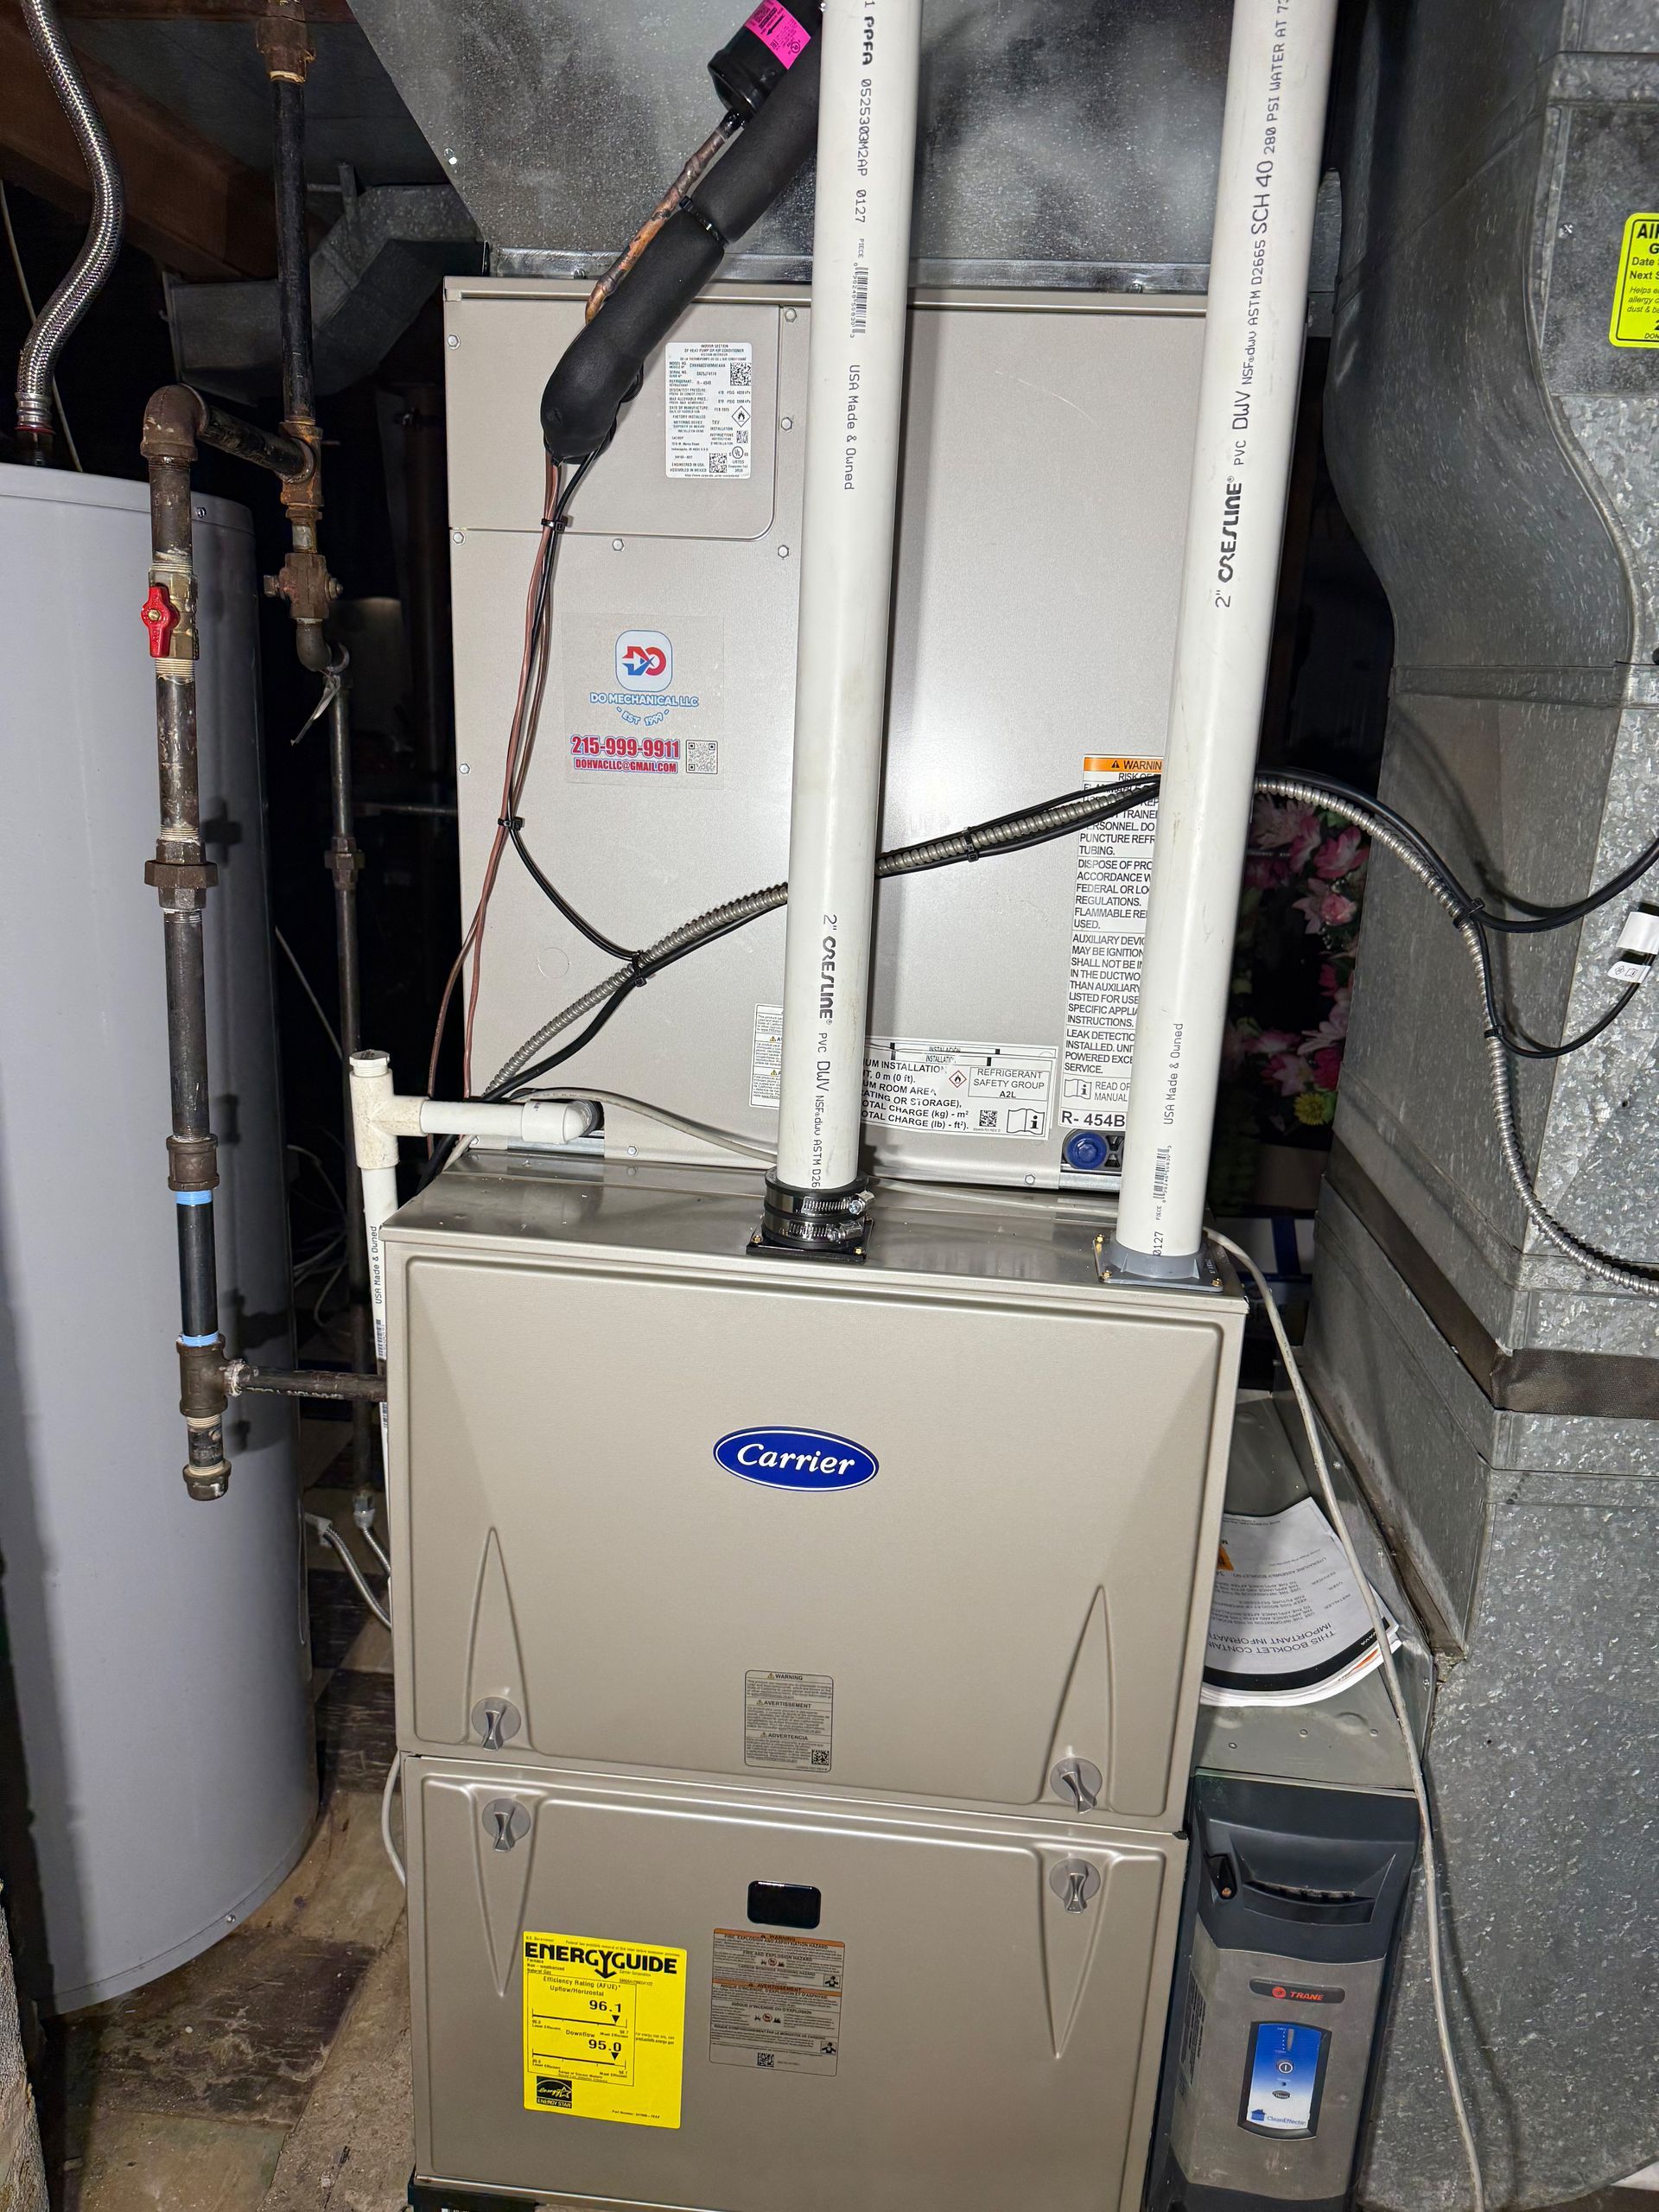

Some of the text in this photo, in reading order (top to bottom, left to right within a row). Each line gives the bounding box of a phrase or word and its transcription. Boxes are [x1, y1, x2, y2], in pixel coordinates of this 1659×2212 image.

[1275, 20, 1287, 37] AT
[1270, 43, 1285, 92] WATER
[1267, 97, 1280, 121] PSI
[855, 16, 875, 224] PPFA 0525303M2AP 0127
[1263, 127, 1276, 155] 280
[1255, 161, 1273, 188] 40
[1251, 194, 1270, 234] SCH
[1251, 239, 1266, 284] D2665
[1631, 257, 1655, 266] Date
[1630, 270, 1652, 280] Next
[1630, 286, 1651, 295] Helps
[1628, 296, 1653, 305] allergy
[1248, 290, 1261, 326] ASTM
[849, 365, 861, 391] USA
[847, 395, 859, 429] Made
[1232, 391, 1250, 429] DWV
[1234, 440, 1247, 466] PVC
[844, 448, 856, 490] Owned
[590, 692, 699, 707] DO MECHANICAL LLC
[621, 712, 664, 726] EST 1999
[571, 736, 679, 759] 215-999-9911
[575, 759, 677, 773] DOHVACLLC@GMAIL.COM
[1118, 772, 1139, 781] RISK
[1123, 810, 1158, 819] TRAINE
[1141, 823, 1154, 831] DO
[1080, 833, 1130, 843] PUNCTURE
[1079, 846, 1116, 855] TUBING.
[1078, 860, 1118, 869] DISPOSE
[1119, 861, 1133, 869] OF
[1077, 871, 1142, 882] ACCORDANCE
[1076, 883, 1150, 894] FEDERAL OR LO
[1076, 895, 1141, 906] REGULATIONS.
[1075, 907, 1147, 918] FLAMMABLE RE
[1074, 918, 1101, 929] USED.
[1072, 934, 1120, 944] AUXILIARY
[1071, 945, 1144, 957] MAY BE IGNITION
[1071, 957, 1135, 969] SHALL NOT BE
[1070, 969, 1141, 981] IN THE DUCTWO
[1070, 980, 1141, 993] THAN AUXILIARY
[1069, 992, 1139, 1004] LISTED FOR USE
[1068, 1003, 1108, 1014] SPECIFIC
[1068, 1014, 1135, 1027] INSTRUCTIONS.
[1066, 1028, 1090, 1039] LEAK
[818, 1032, 828, 1052] PVC
[1065, 1040, 1115, 1052] INSTALLED.
[1170, 1023, 1184, 1059] Owned
[863, 1058, 879, 1068] UM
[1065, 1052, 1110, 1063] POWERED
[977, 1068, 1043, 1079] REFRIGERANT
[1065, 1062, 1103, 1074] SERVICE.
[817, 1061, 830, 1091] DWV
[893, 1073, 901, 1082] (0
[880, 1084, 907, 1094] ROOM
[973, 1078, 1045, 1090] SAFETY GROUP
[1095, 1081, 1118, 1090] READ
[1166, 1072, 1179, 1101] Made
[861, 1090, 891, 1102] ATING
[893, 1096, 907, 1105] OR
[1094, 1092, 1128, 1102] MANUAL
[889, 1104, 929, 1117] CHARGE
[931, 1109, 949, 1119] (kg)
[1164, 1103, 1174, 1125] USA
[888, 1115, 929, 1128] CHARGE
[931, 1121, 945, 1129] (lb)
[1084, 1113, 1125, 1127] 454B
[812, 1139, 822, 1166] ASTM
[737, 1443, 855, 1475] Carrier
[1270, 1623, 1332, 1644] IMPORTANT
[1312, 1630, 1336, 1645] THIS
[1256, 1643, 1308, 1654] BOOKLET
[764, 1700, 811, 1709] AVERTISSEMENT
[768, 1732, 809, 1741] ADVERTENCIA
[525, 1942, 677, 1979] ENERGYGUIDE
[543, 1976, 573, 1986] Efficiency
[575, 1980, 594, 1988] Rating
[550, 1985, 605, 1997] Upflow/Horizontal
[1290, 1992, 1325, 2001] TRANE
[589, 1999, 622, 2013] 96.1
[566, 2030, 595, 2038] Downflow
[588, 2039, 622, 2052] 95.0
